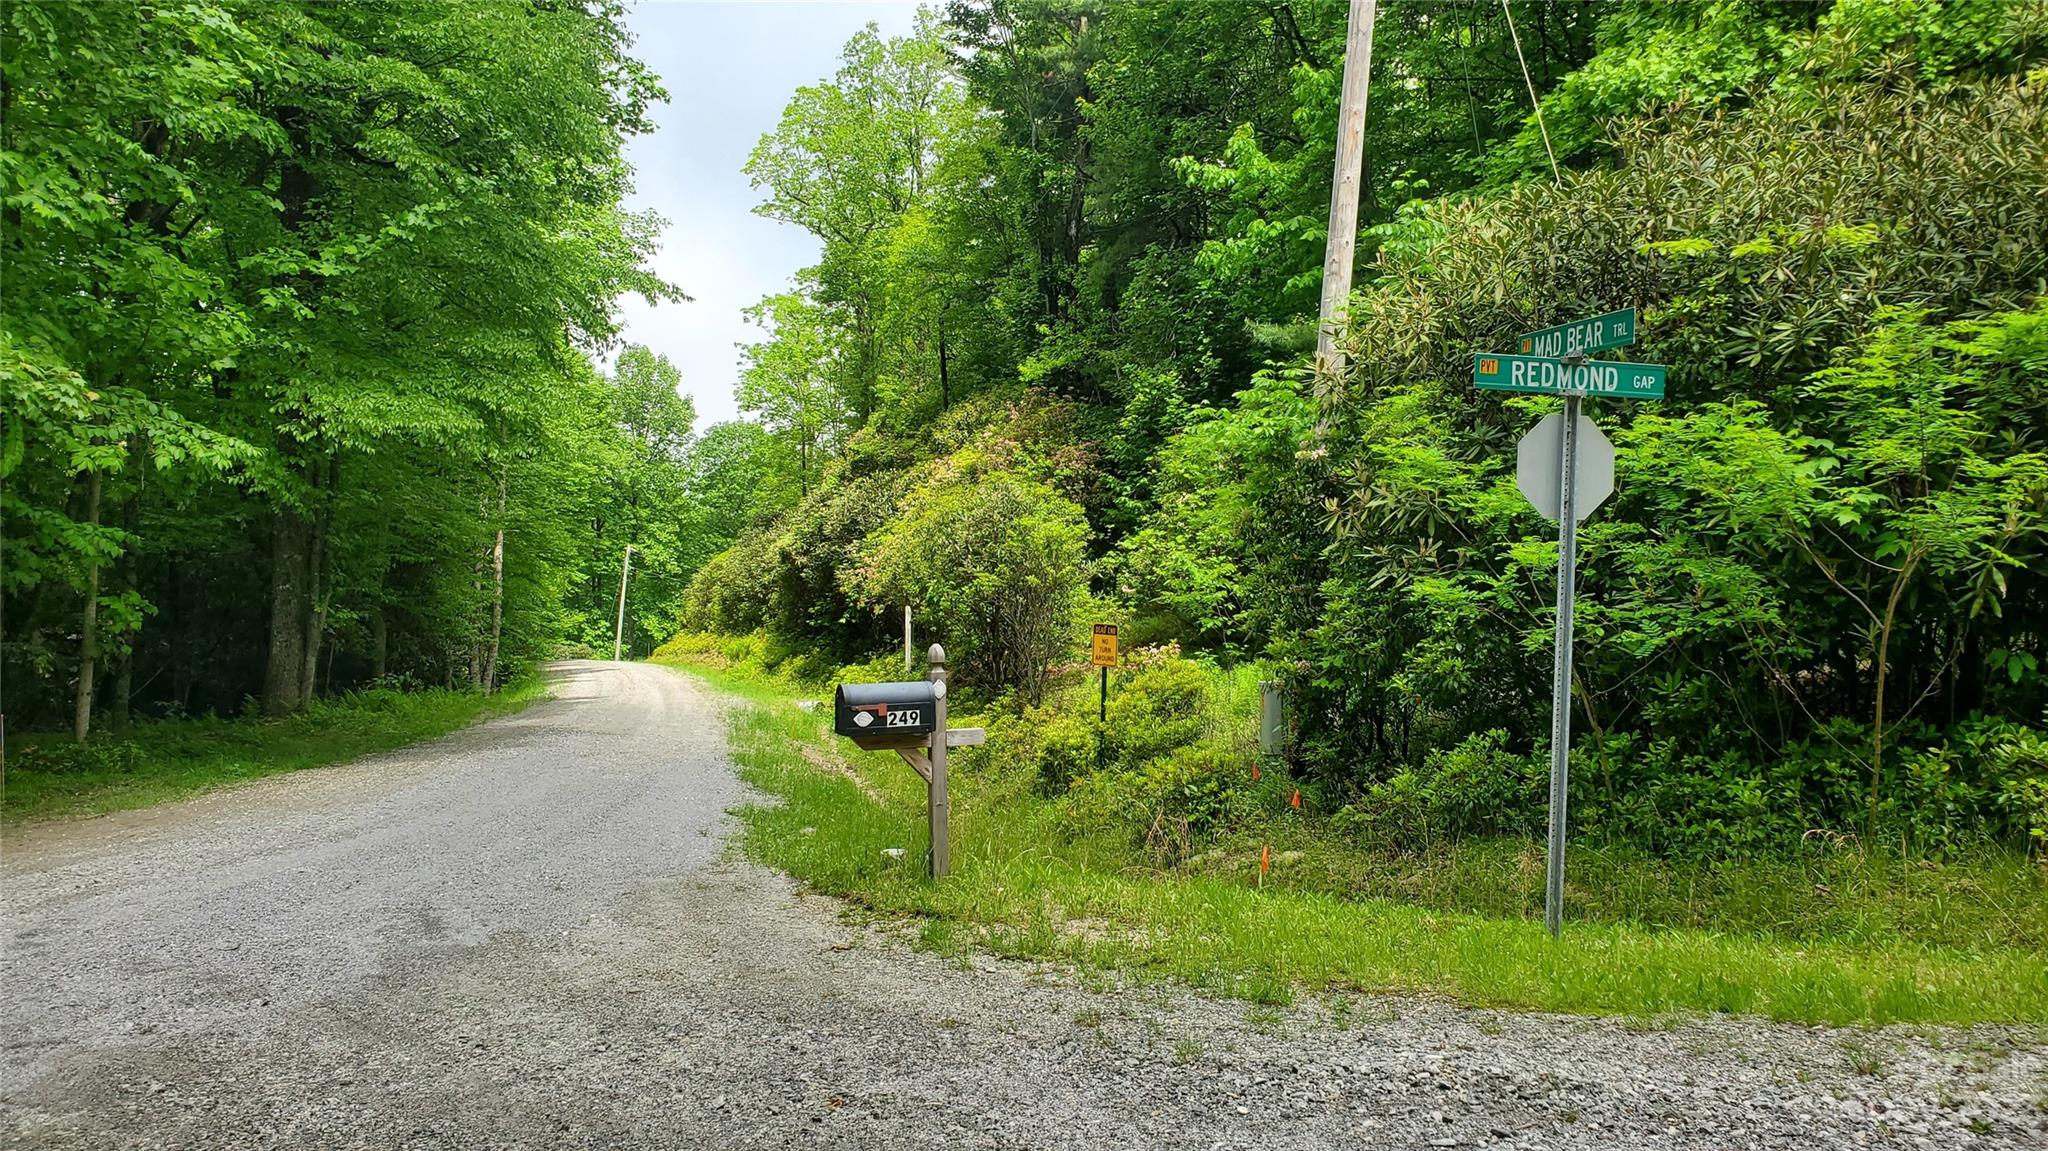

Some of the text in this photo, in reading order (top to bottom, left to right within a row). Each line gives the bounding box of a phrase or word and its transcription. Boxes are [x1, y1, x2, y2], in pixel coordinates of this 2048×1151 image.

[1535, 332, 1562, 357] MAD
[1567, 321, 1603, 352] BEAR
[1613, 322, 1628, 338] TRL
[1480, 359, 1655, 392] PVT REDMOND GAP
[1095, 654, 1115, 662] AROUND
[888, 711, 919, 726] 249
